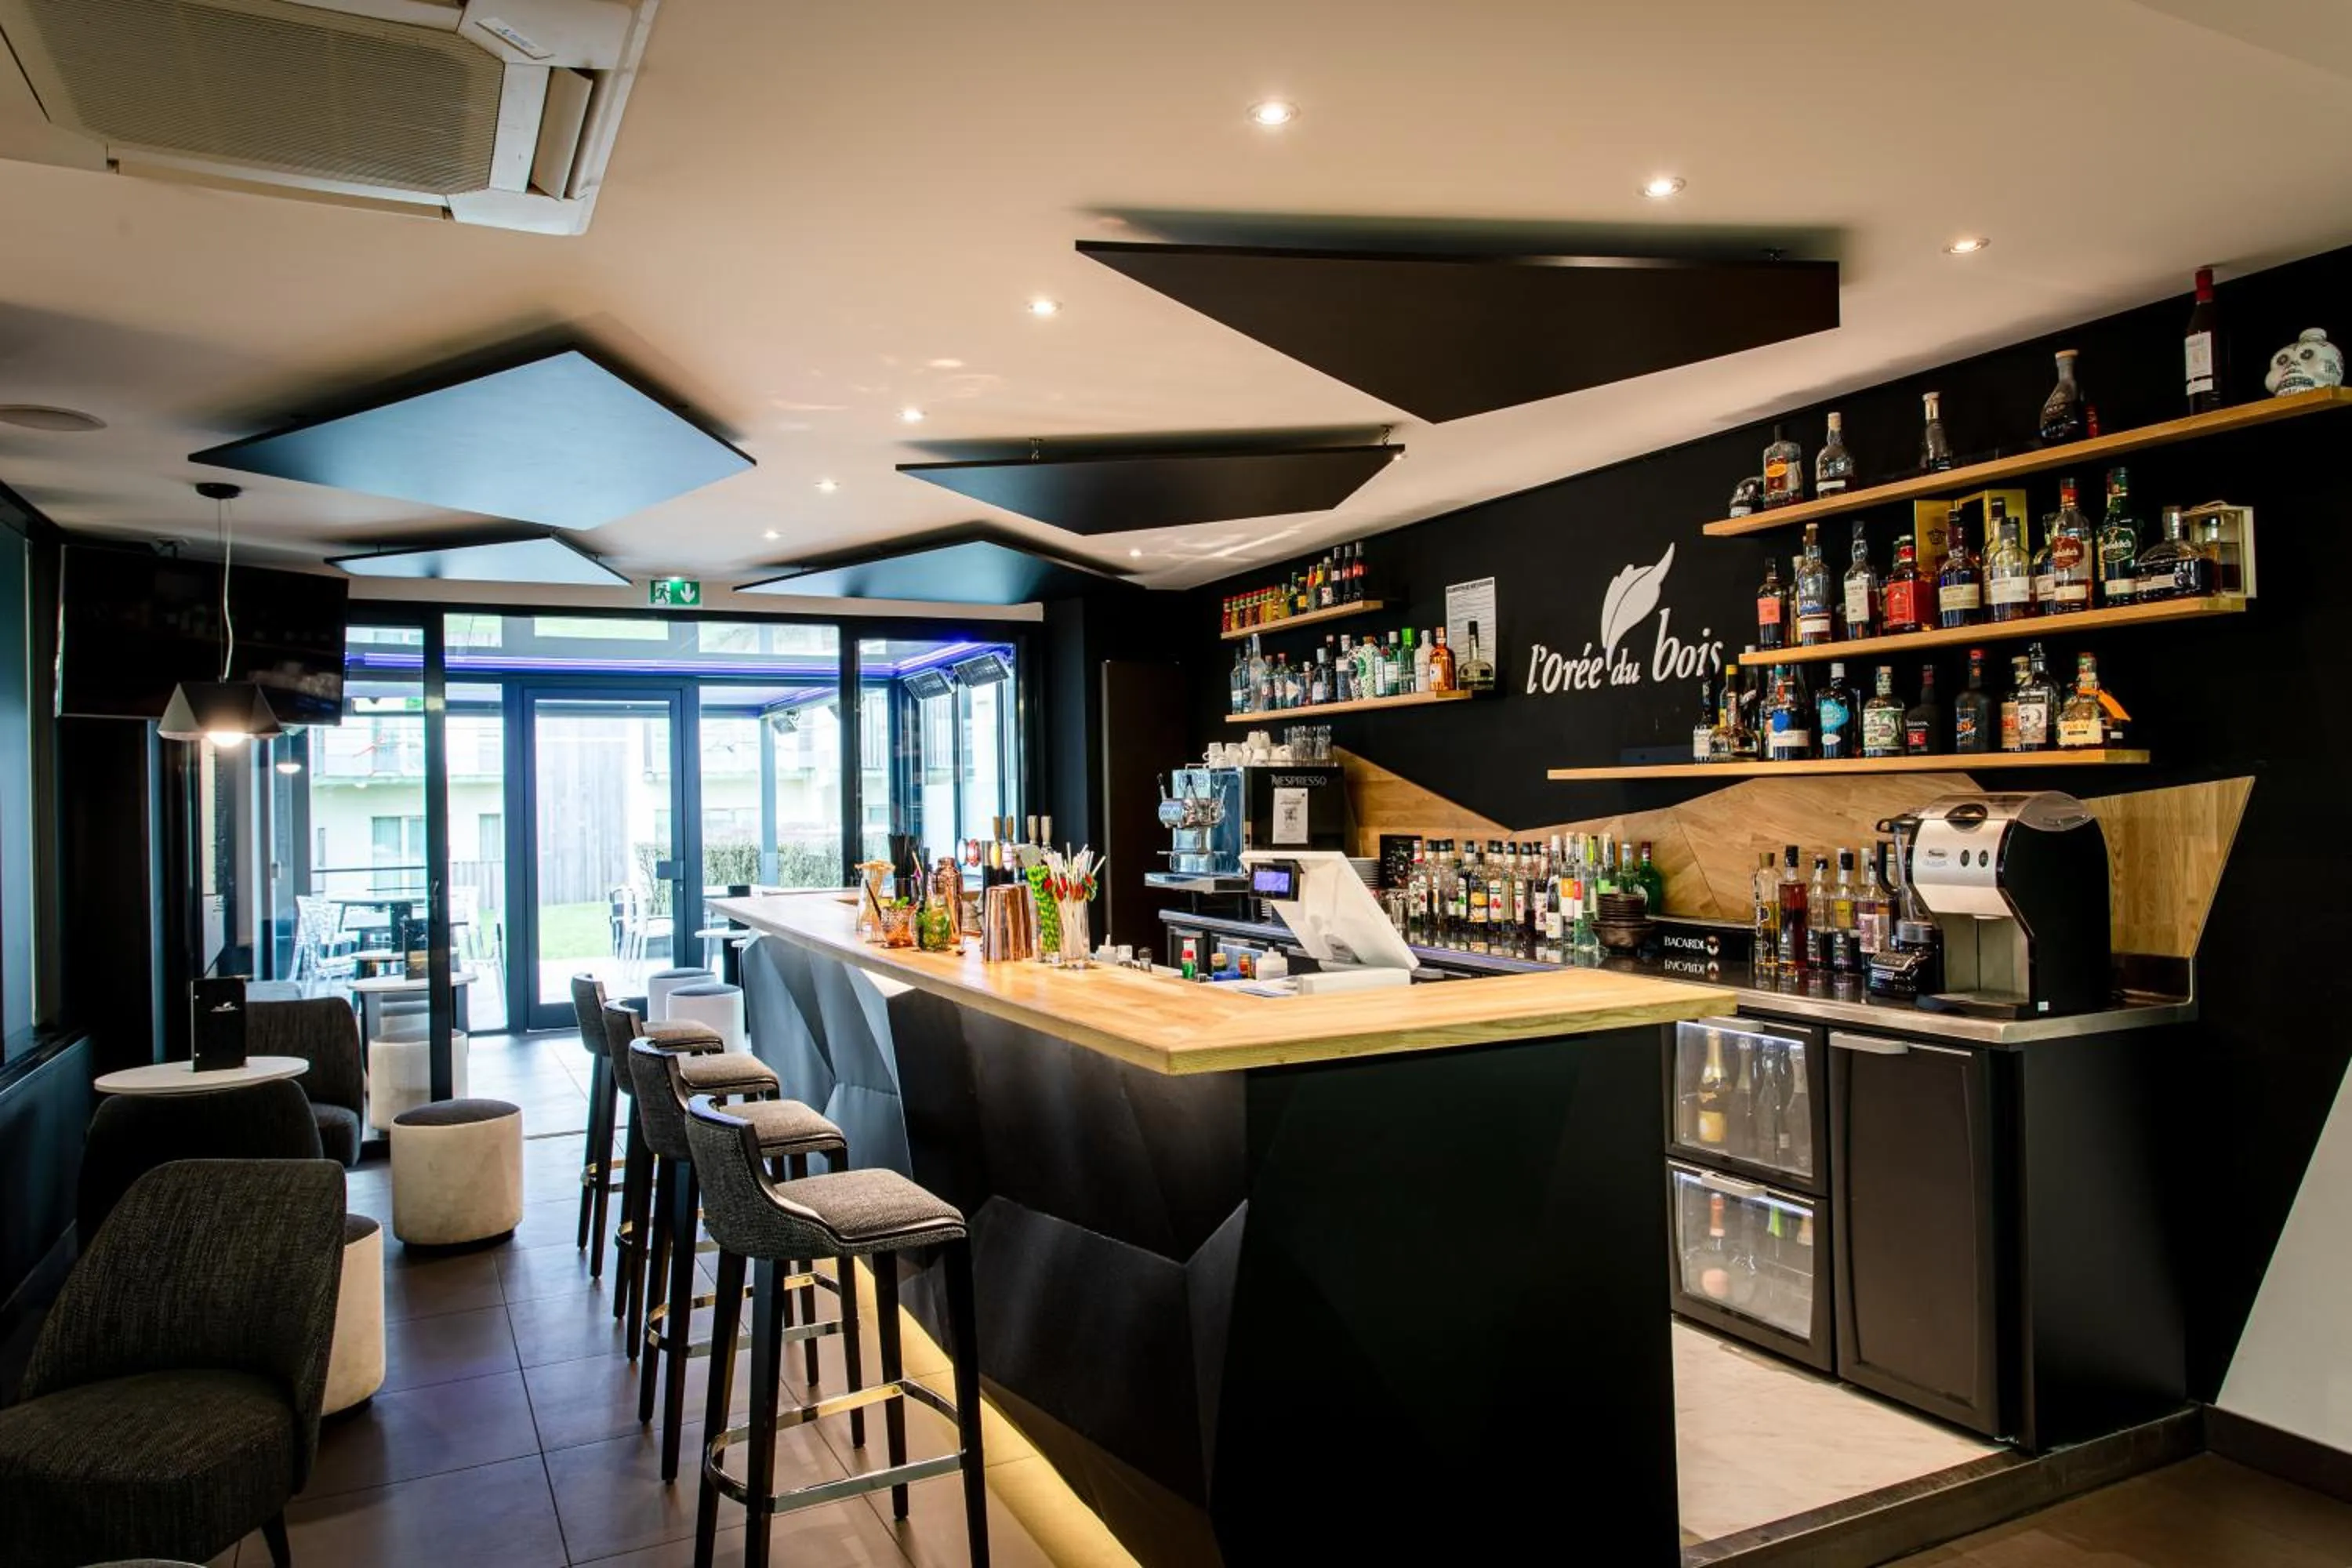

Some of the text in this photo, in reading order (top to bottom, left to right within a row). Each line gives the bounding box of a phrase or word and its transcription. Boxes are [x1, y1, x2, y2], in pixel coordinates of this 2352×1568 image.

[1526, 607, 1724, 695] l'Orée du bois
[1270, 774, 1327, 787] NESPRESSO
[1664, 935, 1705, 950] BACARDI
